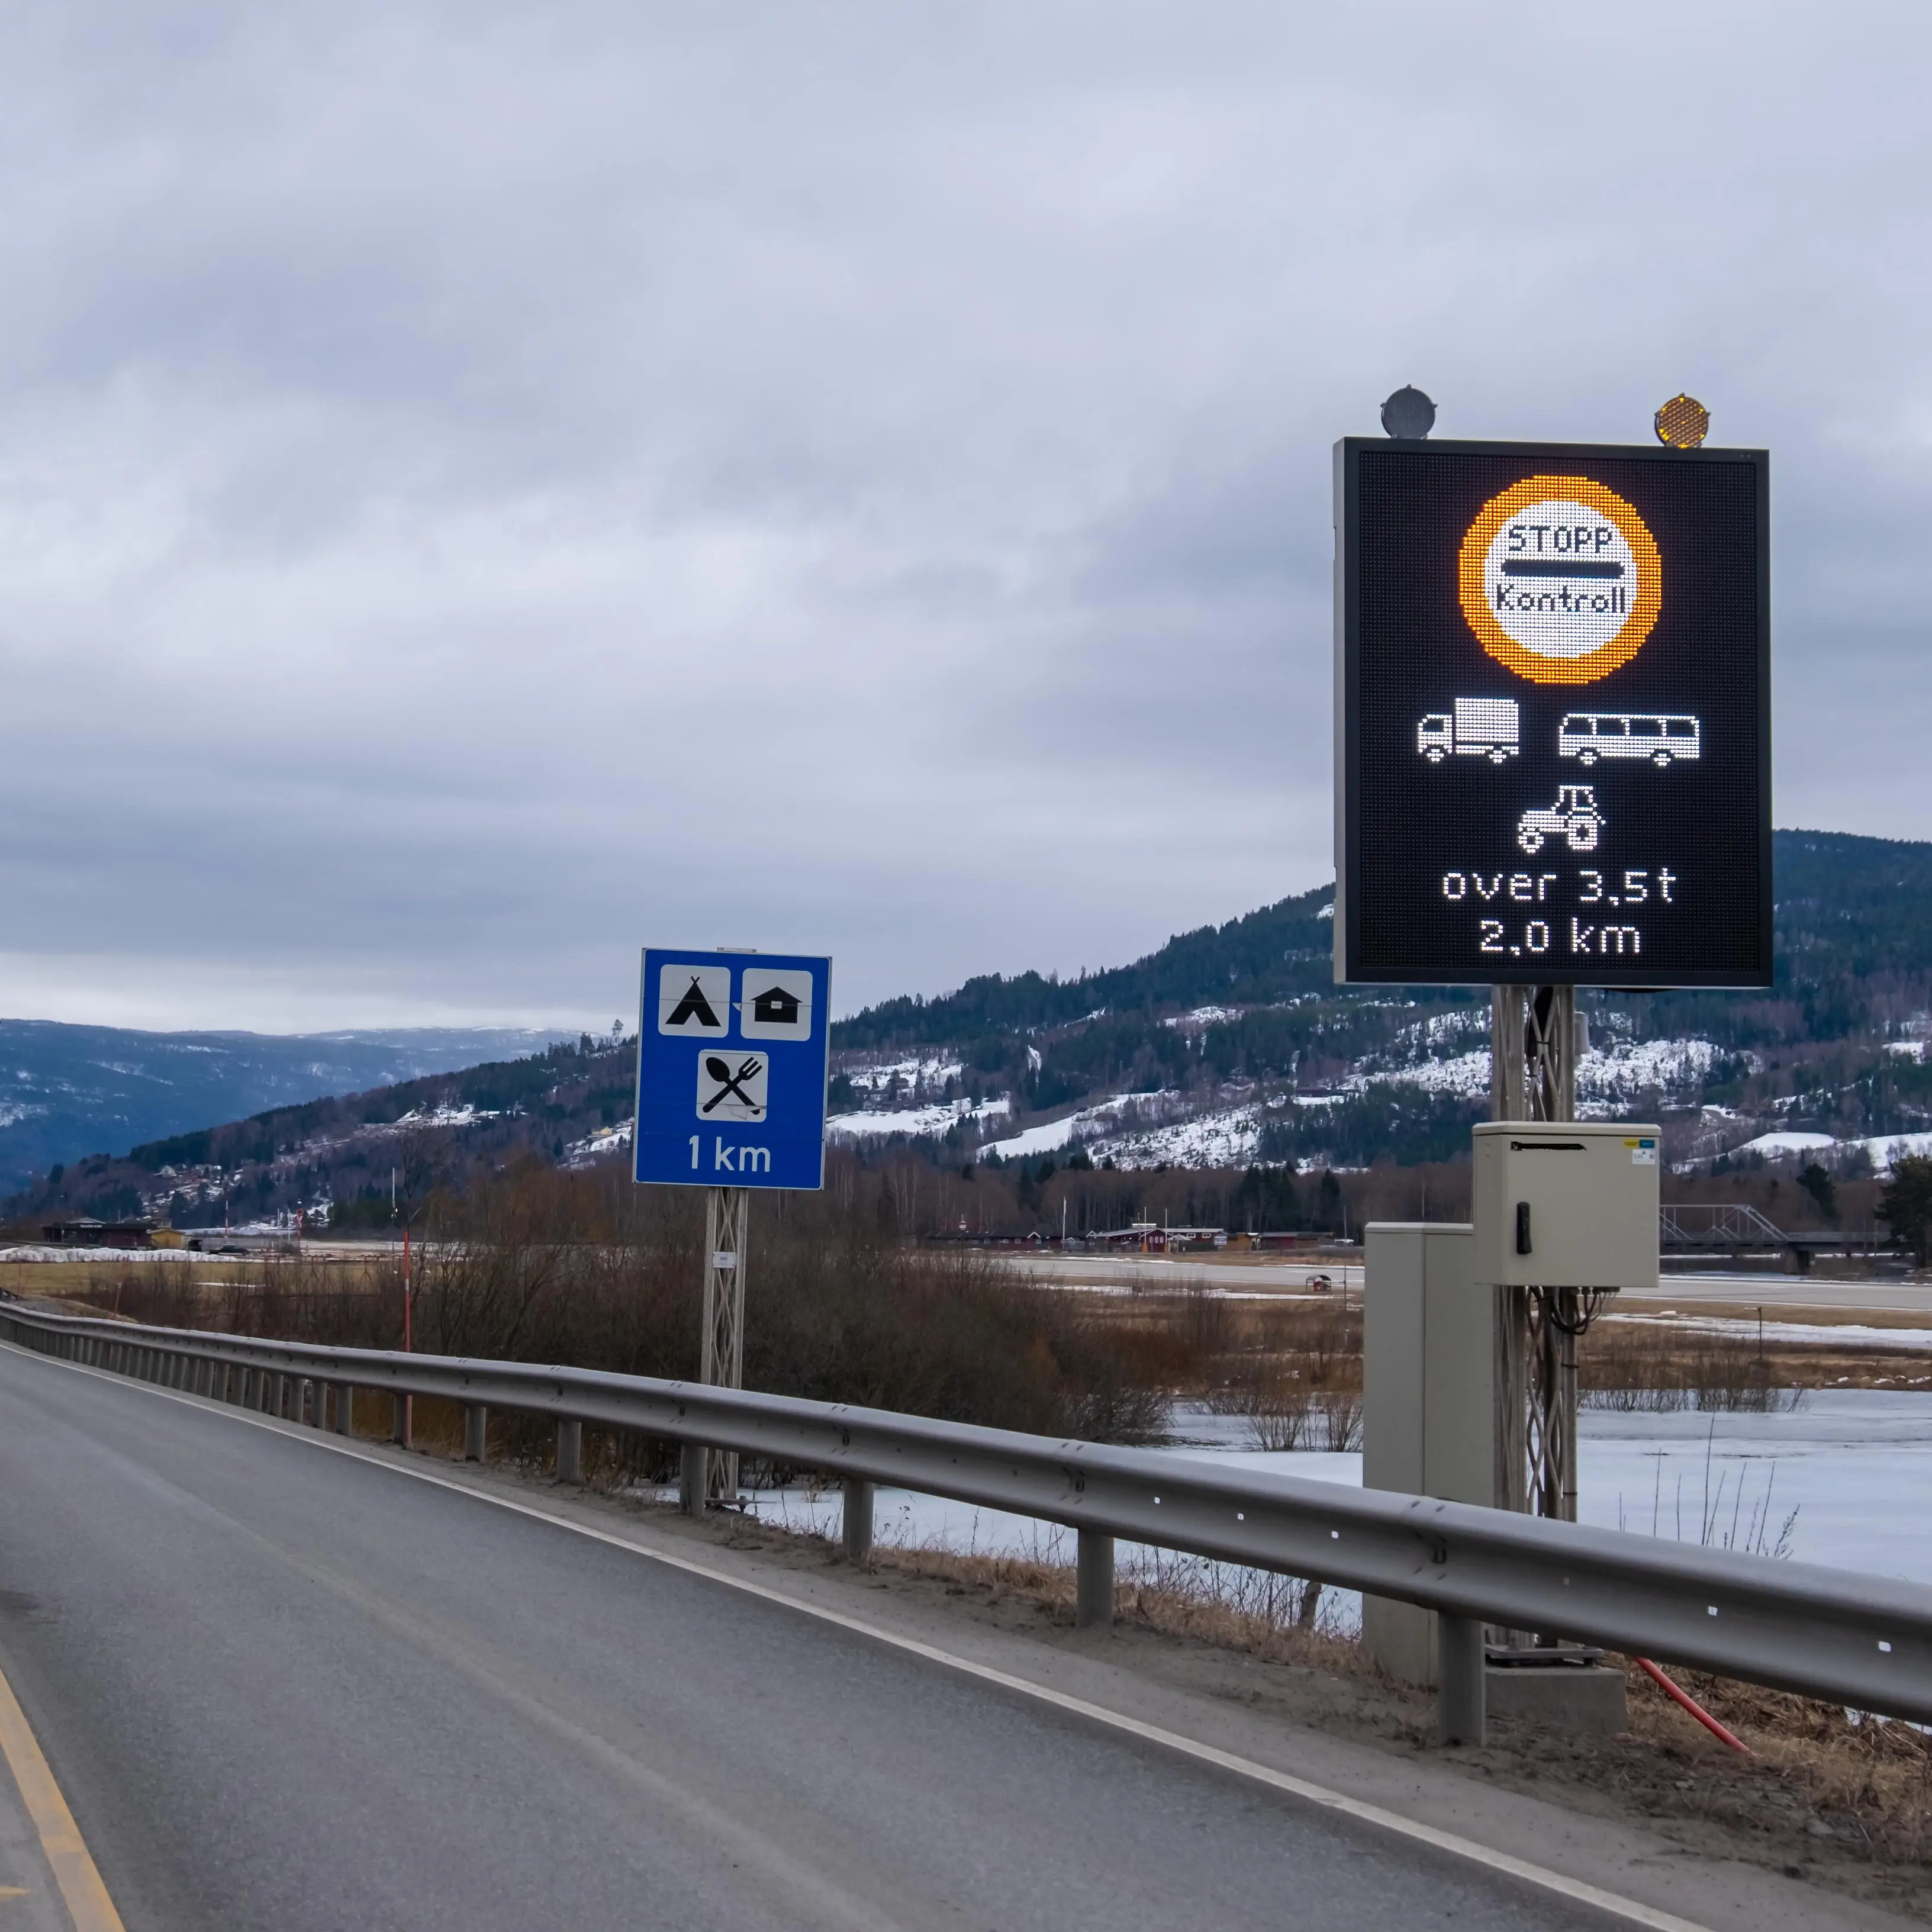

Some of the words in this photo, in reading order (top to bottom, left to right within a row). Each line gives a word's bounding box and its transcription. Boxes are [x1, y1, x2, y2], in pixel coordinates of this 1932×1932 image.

[1509, 526, 1612, 553] STOPP
[1496, 584, 1626, 613] Kontroll
[1444, 873, 1557, 900] over
[1481, 918, 1549, 955] 2,0
[1572, 917, 1640, 953] km
[689, 1135, 700, 1170] 1
[715, 1136, 771, 1173] km
